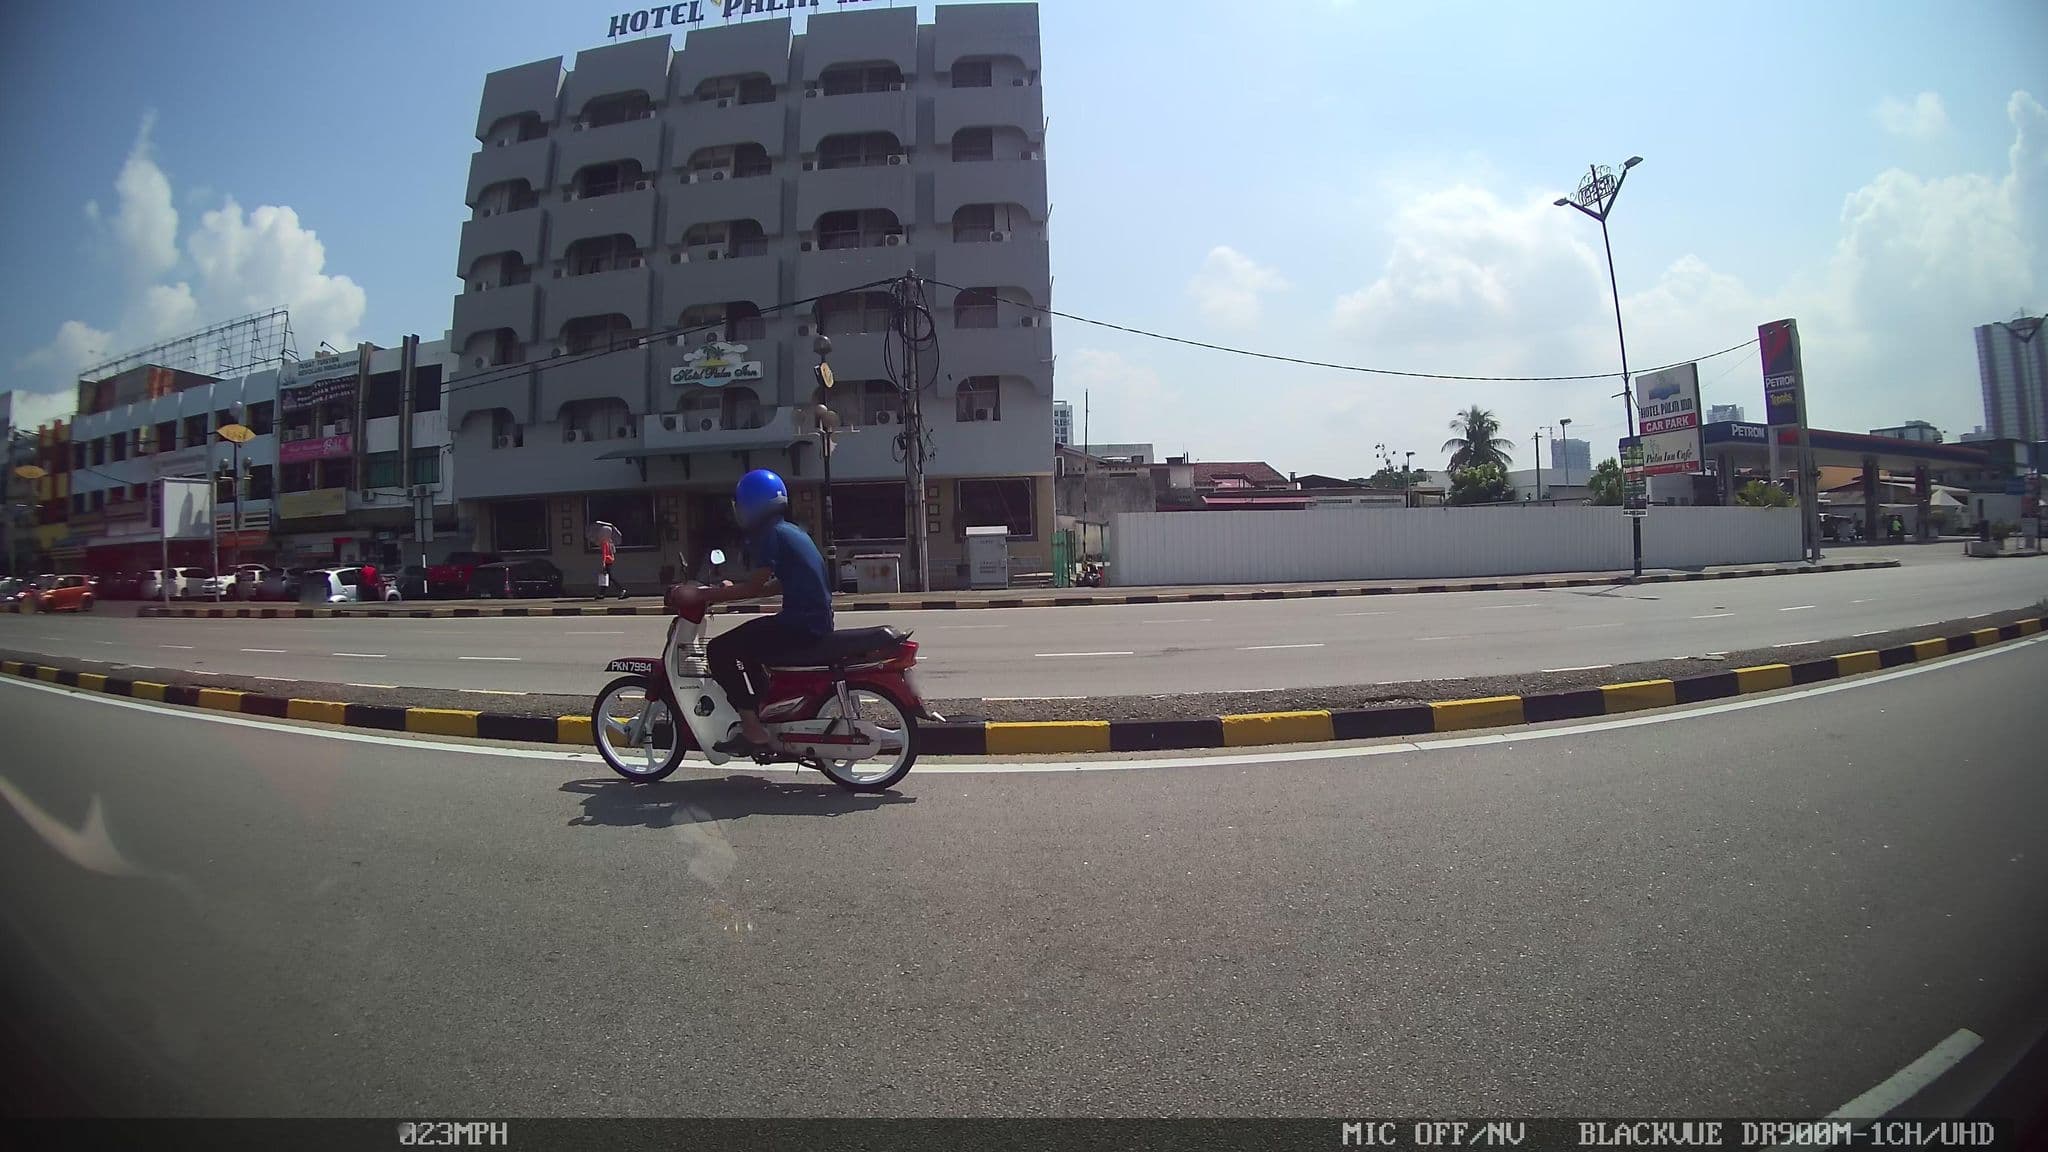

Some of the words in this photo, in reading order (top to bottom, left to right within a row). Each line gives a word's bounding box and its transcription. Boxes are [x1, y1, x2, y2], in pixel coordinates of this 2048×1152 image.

[607, 0, 704, 37] HOTEL
[673, 369, 704, 382] Hotel
[735, 364, 758, 378] Inn
[1765, 375, 1795, 388] PETRON
[1640, 404, 1660, 419] HOTEL
[1646, 420, 1664, 432] CAR
[1665, 415, 1689, 429] PARK
[1731, 423, 1765, 438] PETRON
[1646, 452, 1663, 464] Palm
[1664, 451, 1675, 462] Inn
